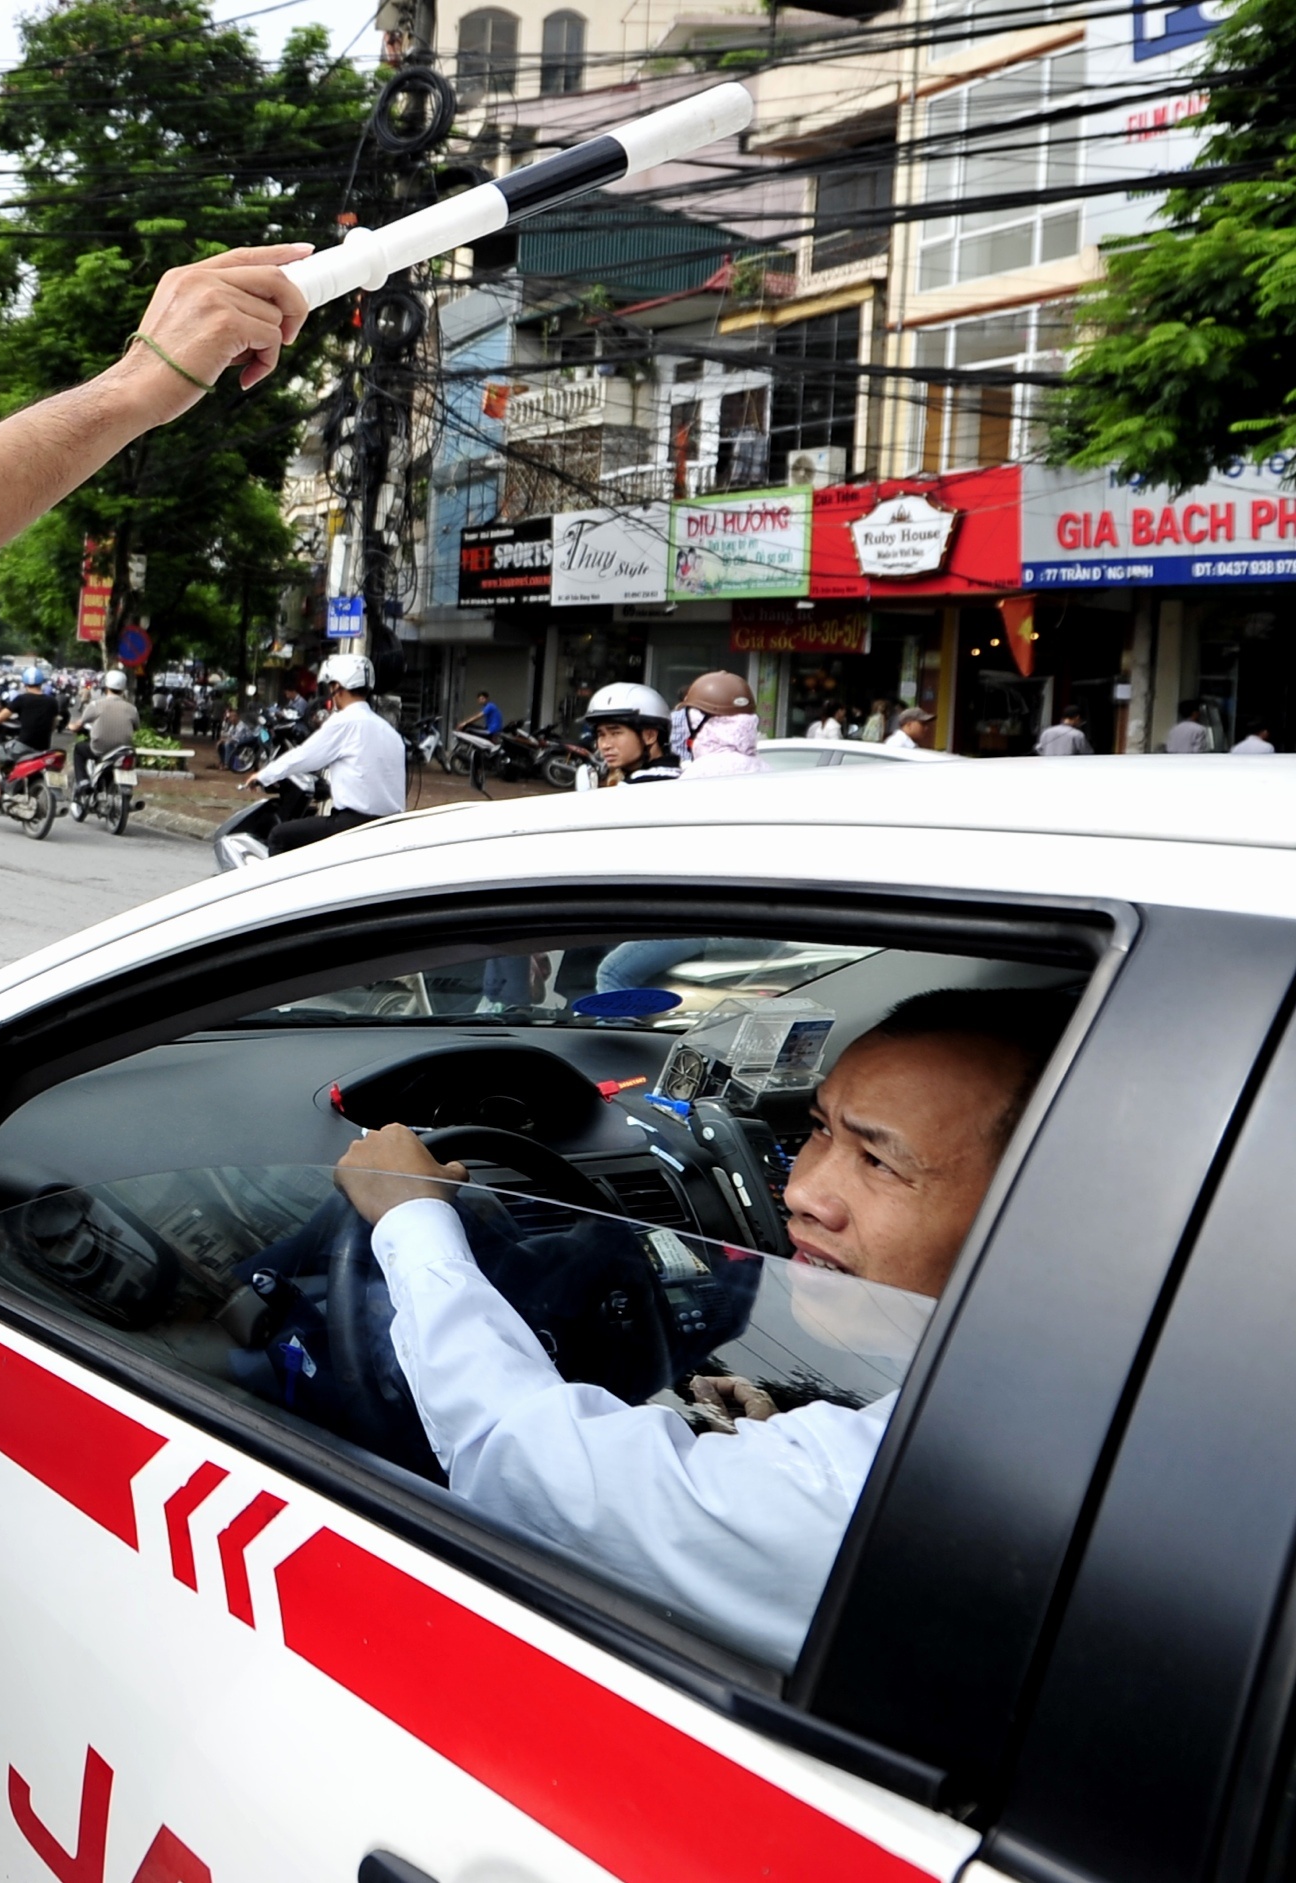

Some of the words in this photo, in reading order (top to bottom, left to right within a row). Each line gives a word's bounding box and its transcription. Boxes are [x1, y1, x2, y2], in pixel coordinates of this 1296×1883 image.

[864, 530, 896, 546] Ruby
[901, 527, 941, 542] House
[1058, 511, 1118, 549] GIA
[1132, 502, 1235, 546] BACH
[494, 540, 553, 570] SPORTS
[614, 561, 650, 578] Style
[736, 627, 765, 649] Giá
[769, 628, 797, 650] sốc
